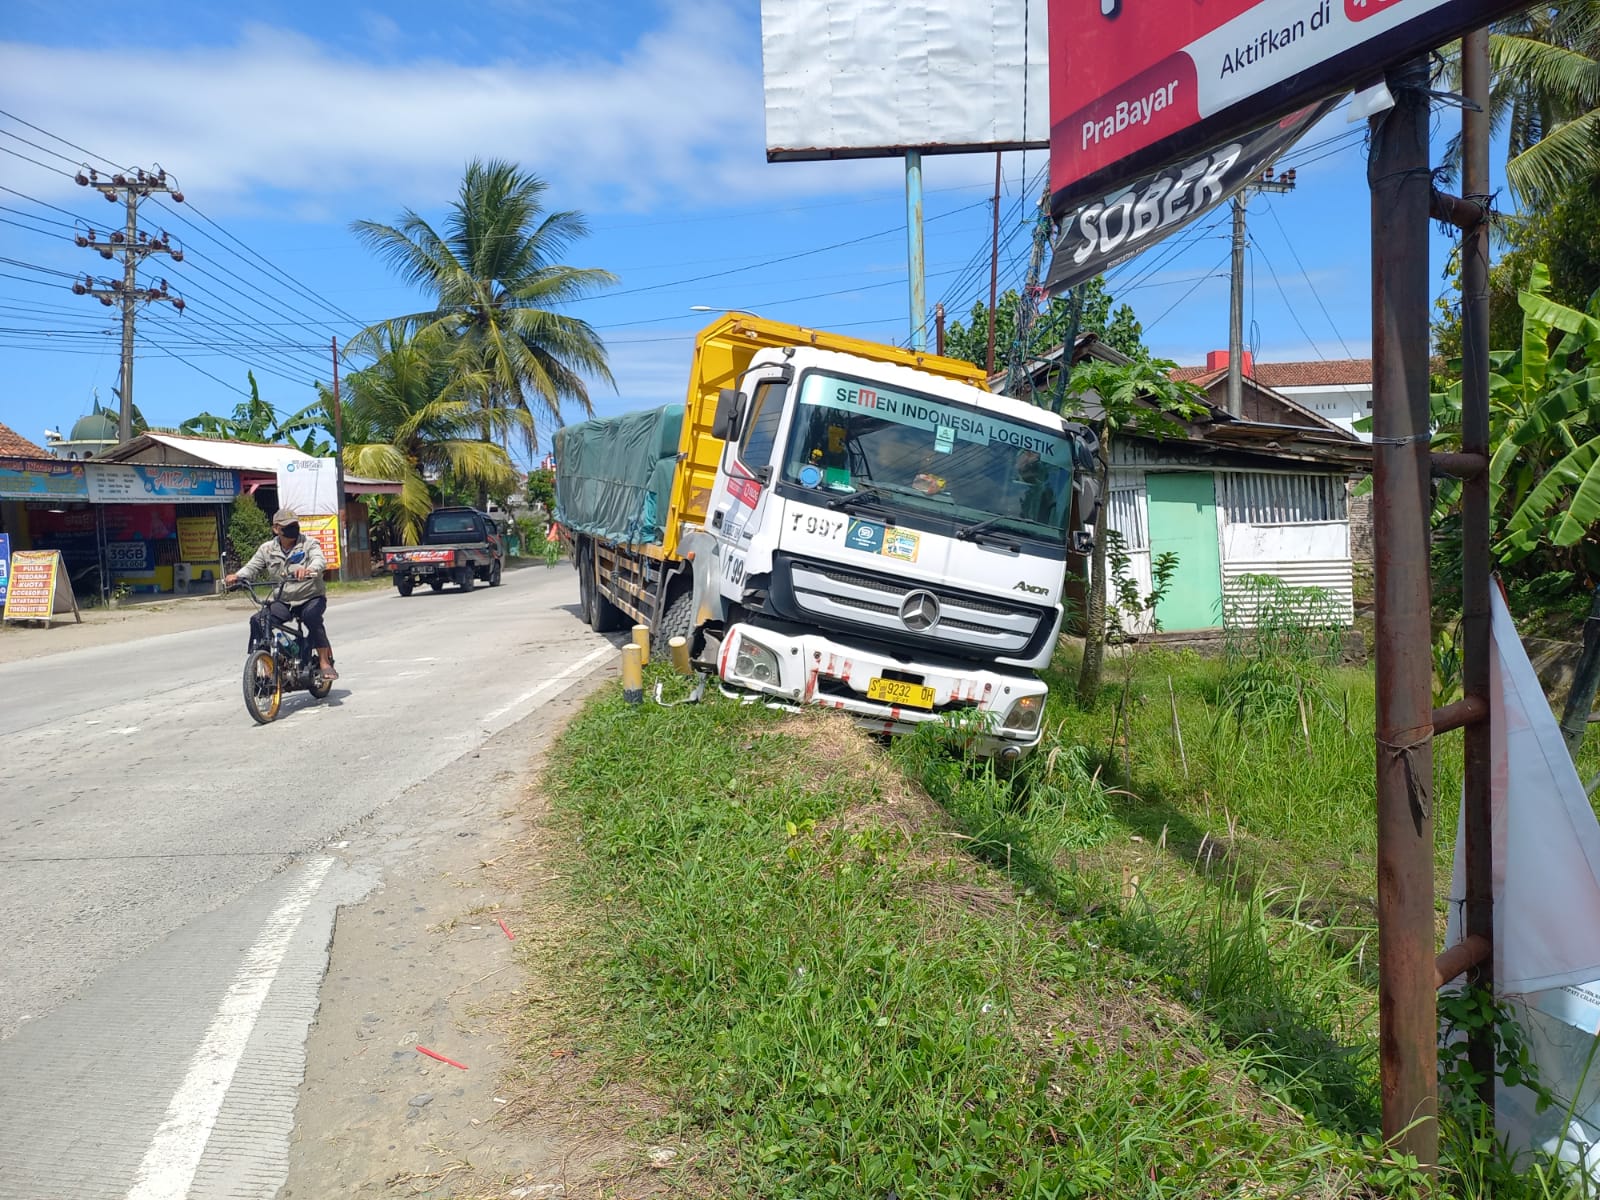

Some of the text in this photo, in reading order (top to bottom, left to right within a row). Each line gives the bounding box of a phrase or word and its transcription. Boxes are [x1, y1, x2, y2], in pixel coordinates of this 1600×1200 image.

[1219, 1, 1330, 80] Aktifkan di
[1081, 78, 1180, 150] PraBayar
[1072, 143, 1243, 266] SOBER
[836, 388, 1055, 457] SEMEN INDONESIA LOGISTIK
[110, 549, 144, 559] 39GB
[792, 512, 843, 540] T 997
[870, 680, 878, 692] S
[887, 682, 911, 698] 9232
